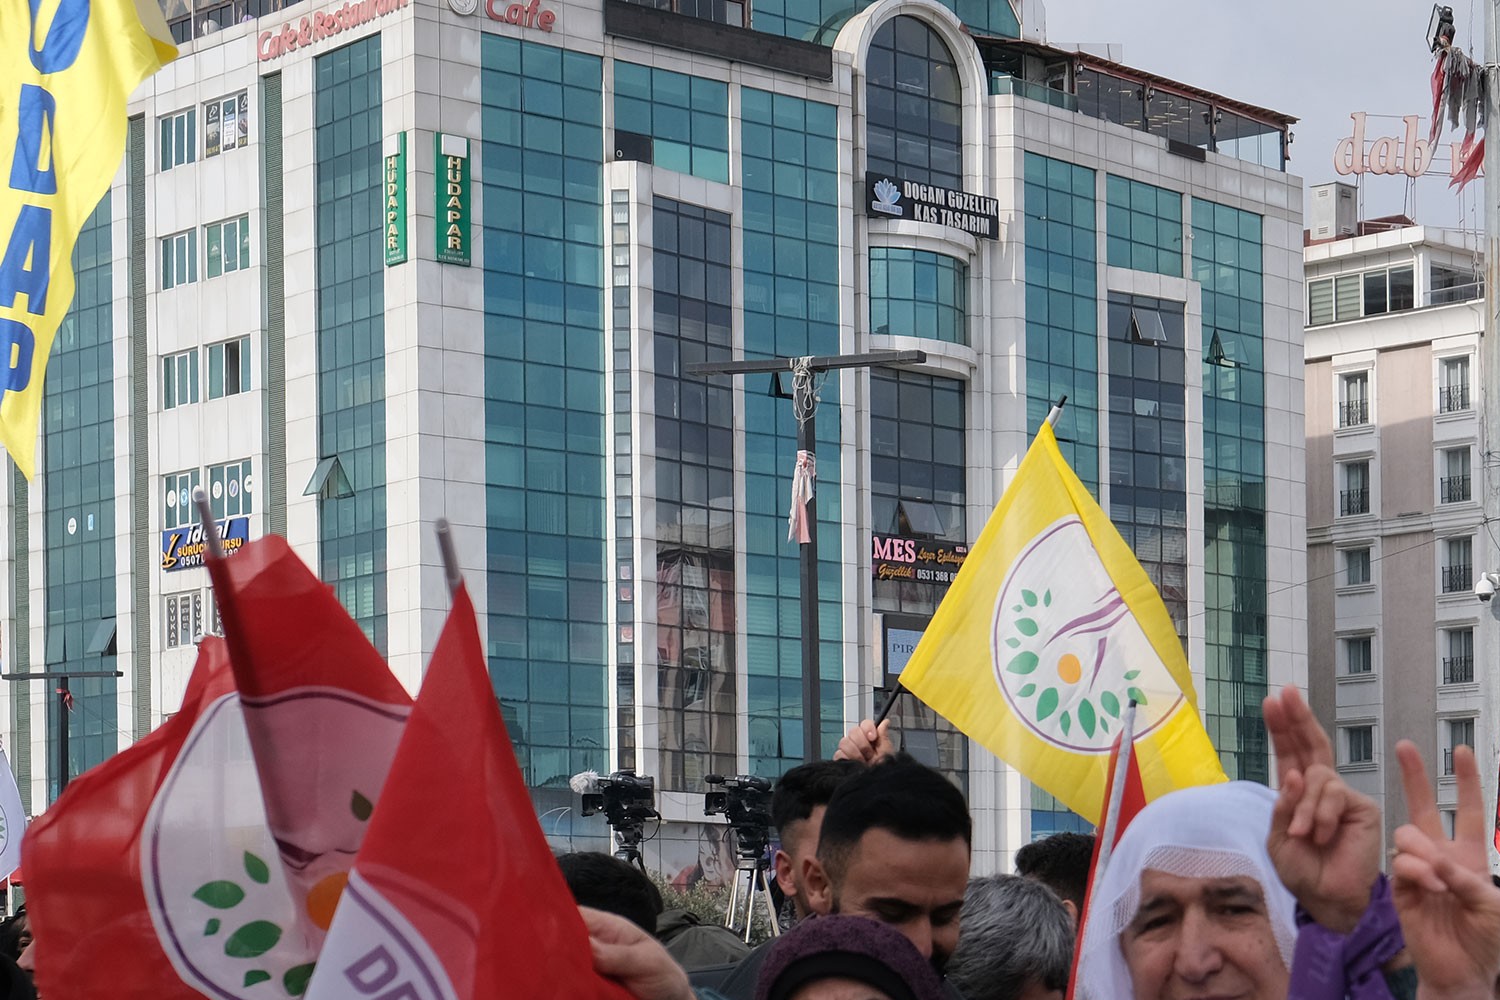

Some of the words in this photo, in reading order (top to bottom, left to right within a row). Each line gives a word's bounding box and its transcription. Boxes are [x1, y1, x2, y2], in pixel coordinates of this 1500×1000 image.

[257, 22, 298, 61] Cafe
[311, 0, 409, 41] Restauran
[485, 0, 556, 33] Cafe
[1334, 112, 1430, 177] dab
[940, 209, 990, 235] TASARIM
[872, 536, 917, 563] MES
[168, 599, 176, 647] AVUKAT
